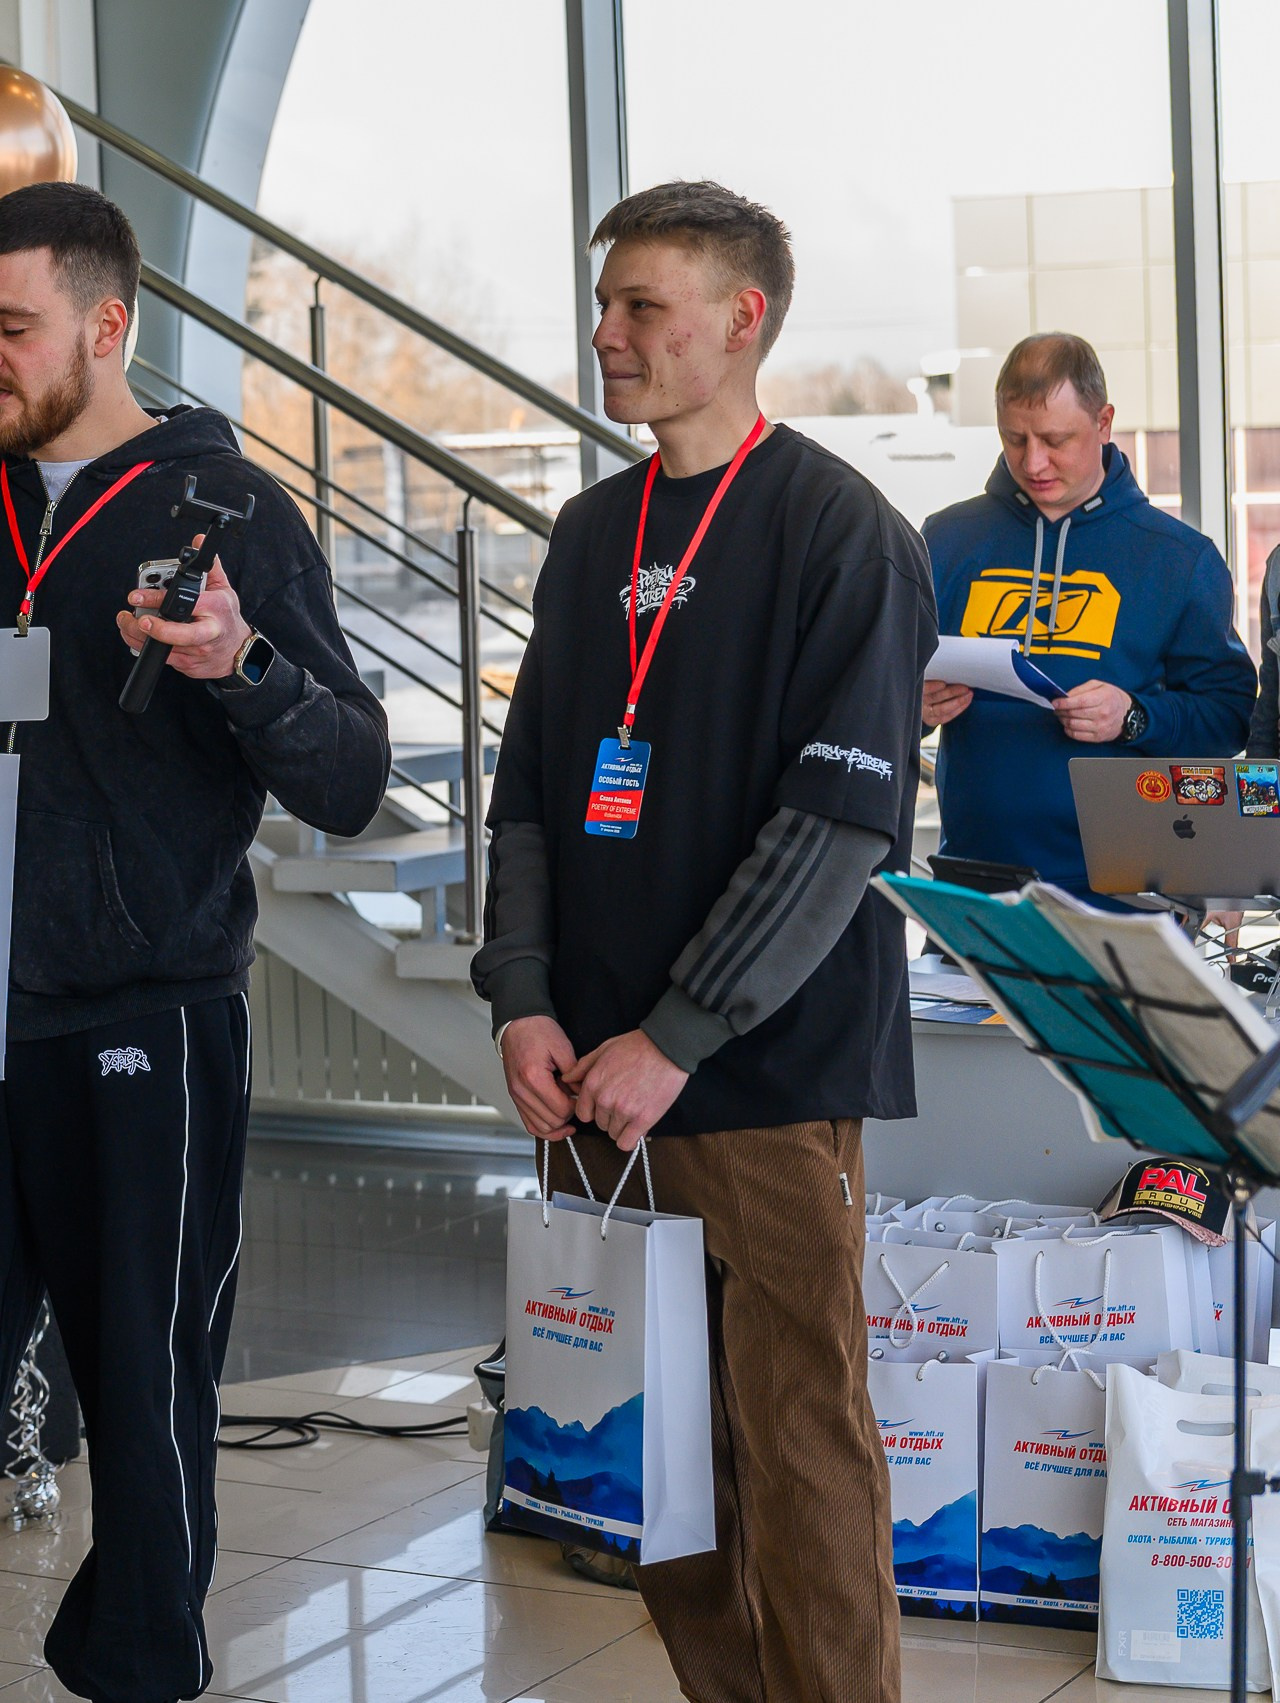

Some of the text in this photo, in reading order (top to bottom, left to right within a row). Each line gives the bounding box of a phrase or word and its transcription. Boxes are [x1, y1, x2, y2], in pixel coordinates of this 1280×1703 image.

[847, 748, 893, 778] EXTREME
[598, 775, 640, 788] ОСОБЫЙ ГОСТЬ
[591, 803, 609, 811] POETRY
[616, 806, 636, 815] EXTREME
[1137, 1167, 1207, 1203] PAL
[1136, 1191, 1203, 1211] TROUT
[1102, 1304, 1136, 1312] ww.hft.ru
[524, 1299, 615, 1334] АКТИВНЫЙ ОТДЫХ
[936, 1315, 969, 1325] www.hft.ru
[1026, 1311, 1136, 1328] АКИВНЫЙ ОДЫХ
[927, 1321, 968, 1337] ОТДЫХ
[532, 1326, 604, 1352] ВСЁ ЛУЧШЕЕ ДЛЯ ВАС
[1090, 1332, 1108, 1343] ДЯ
[1109, 1332, 1126, 1342] ВАС
[899, 1436, 944, 1451] ОТДЫХ
[1013, 1440, 1107, 1463] АКТИВНЫЙ ОТД
[895, 1455, 913, 1465] ДЛЯ
[915, 1457, 932, 1466] ВАС
[1024, 1461, 1040, 1471] ВСЁ
[1040, 1463, 1073, 1475] ЛУЧШЕЕ
[1074, 1467, 1093, 1477] ДЛЯ
[1128, 1495, 1218, 1514] АКТИВНЫЙ
[1167, 1517, 1235, 1528] СЕТЬ МАГАЗИН
[1127, 1534, 1152, 1544] ОХОТА
[1158, 1535, 1197, 1545] РЫБАЛКА
